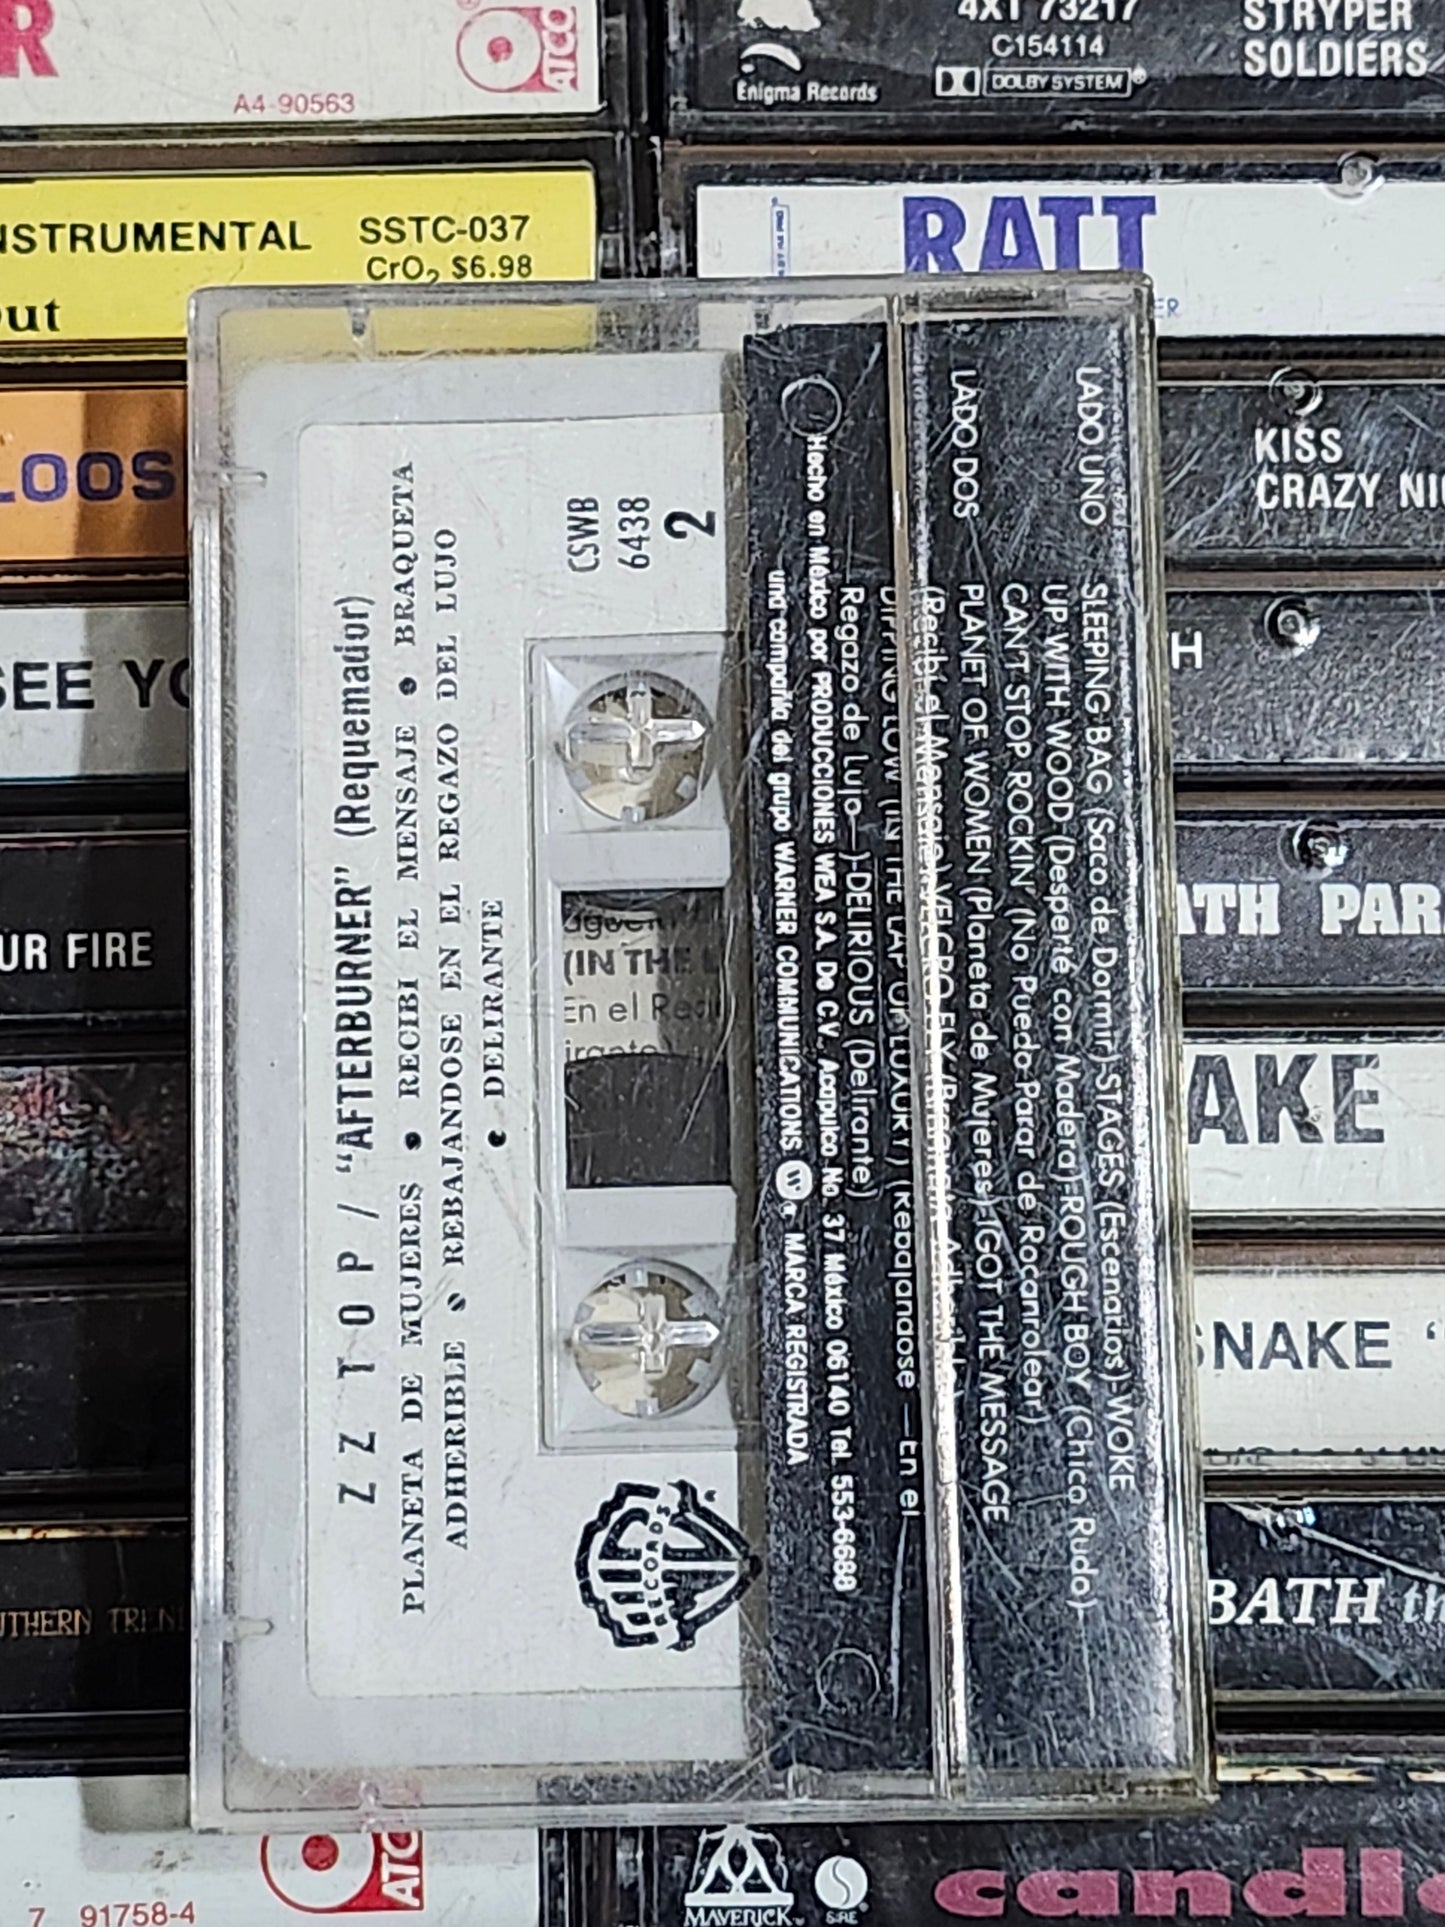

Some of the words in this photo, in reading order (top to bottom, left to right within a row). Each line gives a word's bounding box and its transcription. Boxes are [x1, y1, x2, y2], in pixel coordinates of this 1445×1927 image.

[0, 0, 59, 78] R
[540, 8, 577, 91] ATCO
[992, 33, 1105, 58] C154114
[1243, 0, 1412, 31] STRYPER
[736, 79, 801, 106] Enigma
[806, 80, 878, 103] Records
[992, 74, 1049, 90] DOLBY
[1052, 73, 1124, 91] SYSTEM
[1244, 38, 1429, 77] SOLDIERS
[0, 219, 313, 255] STRUMENTAL
[358, 214, 531, 245] SSTC-037
[451, 253, 533, 280] $6.98
[903, 195, 1157, 274] RATT
[0, 298, 61, 333] ut
[950, 368, 979, 449] LADO
[1075, 366, 1105, 446] LADO
[806, 435, 829, 503] Hecho
[1254, 427, 1342, 464] KISS
[952, 457, 980, 519] DOS
[1078, 454, 1107, 527] UNO
[1256, 472, 1381, 510] CRAZY
[1399, 472, 1445, 510] NI
[392, 461, 419, 647] BRAQUETA
[566, 495, 600, 573] CSWB
[616, 496, 651, 570] 6438
[663, 510, 717, 540] 2
[807, 509, 826, 538] en
[433, 528, 457, 613] LUJO
[767, 569, 788, 610] una
[808, 545, 833, 620] México
[1041, 583, 1069, 623] UP
[805, 628, 830, 664] por
[833, 586, 866, 694] Regazo
[957, 583, 987, 688] PLANET
[1001, 582, 1030, 674] CAN'T
[1080, 582, 1112, 715] SLEEPING
[0, 660, 95, 711] EE
[435, 634, 458, 701] DEL
[1044, 632, 1071, 708] WITH
[332, 596, 380, 837] (Requemador)
[771, 728, 794, 764] del
[842, 702, 871, 741] de
[961, 698, 988, 741] OF
[1003, 683, 1032, 759] STOP
[436, 722, 460, 862] REGAZO
[809, 670, 837, 845] PRODUCCIONES
[1084, 725, 1113, 795] BAG
[395, 725, 419, 881] MENSAJE
[766, 771, 794, 833] grupo
[962, 751, 993, 874] WOMEN
[1005, 770, 1037, 896] ROCKIN'
[812, 851, 839, 903] WEA
[1081, 807, 1118, 886] (Saco
[438, 883, 461, 924] EL
[772, 840, 798, 936] WARNER
[1090, 895, 1119, 934] de
[1319, 882, 1445, 936] PAR
[66, 930, 153, 969] FIRE
[396, 908, 419, 950] EL
[958, 886, 995, 1010] (Planeta
[1003, 907, 1037, 962] (No
[438, 945, 462, 992] EN
[481, 899, 505, 1099] DELIRANTE
[564, 948, 616, 986] (IN
[396, 977, 420, 1099] RECIBI
[608, 991, 639, 1022] el
[969, 1021, 999, 1061] de
[1010, 975, 1042, 1071] Puedo
[1051, 988, 1073, 1042] con
[775, 944, 804, 1151] COMMUNICATIONS
[439, 1013, 465, 1267] REBAJANDOSE
[811, 1058, 843, 1158] Acapulco
[1013, 1081, 1041, 1160] Parar
[1017, 1170, 1045, 1211] de
[821, 1213, 847, 1243] 37
[399, 1182, 423, 1347] MUJERES
[782, 1233, 809, 1315] MARCA
[823, 1253, 852, 1330] México
[977, 1304, 1006, 1361] THE
[1015, 1225, 1051, 1425] Rocanrolear)
[1062, 1323, 1092, 1391] BOY
[1196, 1319, 1393, 1371] NAKE
[400, 1373, 424, 1423] DE
[783, 1323, 812, 1466] REGISTRADA
[825, 1339, 852, 1417] 06140
[442, 1340, 468, 1551] ADHERIBLE
[978, 1371, 1011, 1523] MESSAGE
[1057, 1404, 1096, 1505] (Chico
[401, 1448, 425, 1615] PLANETA
[1065, 1517, 1100, 1609] Rudo)
[0, 1608, 93, 1638] THERN
[80, 1901, 196, 1927] 91758-4
[683, 1906, 793, 1927] MAVERICK
